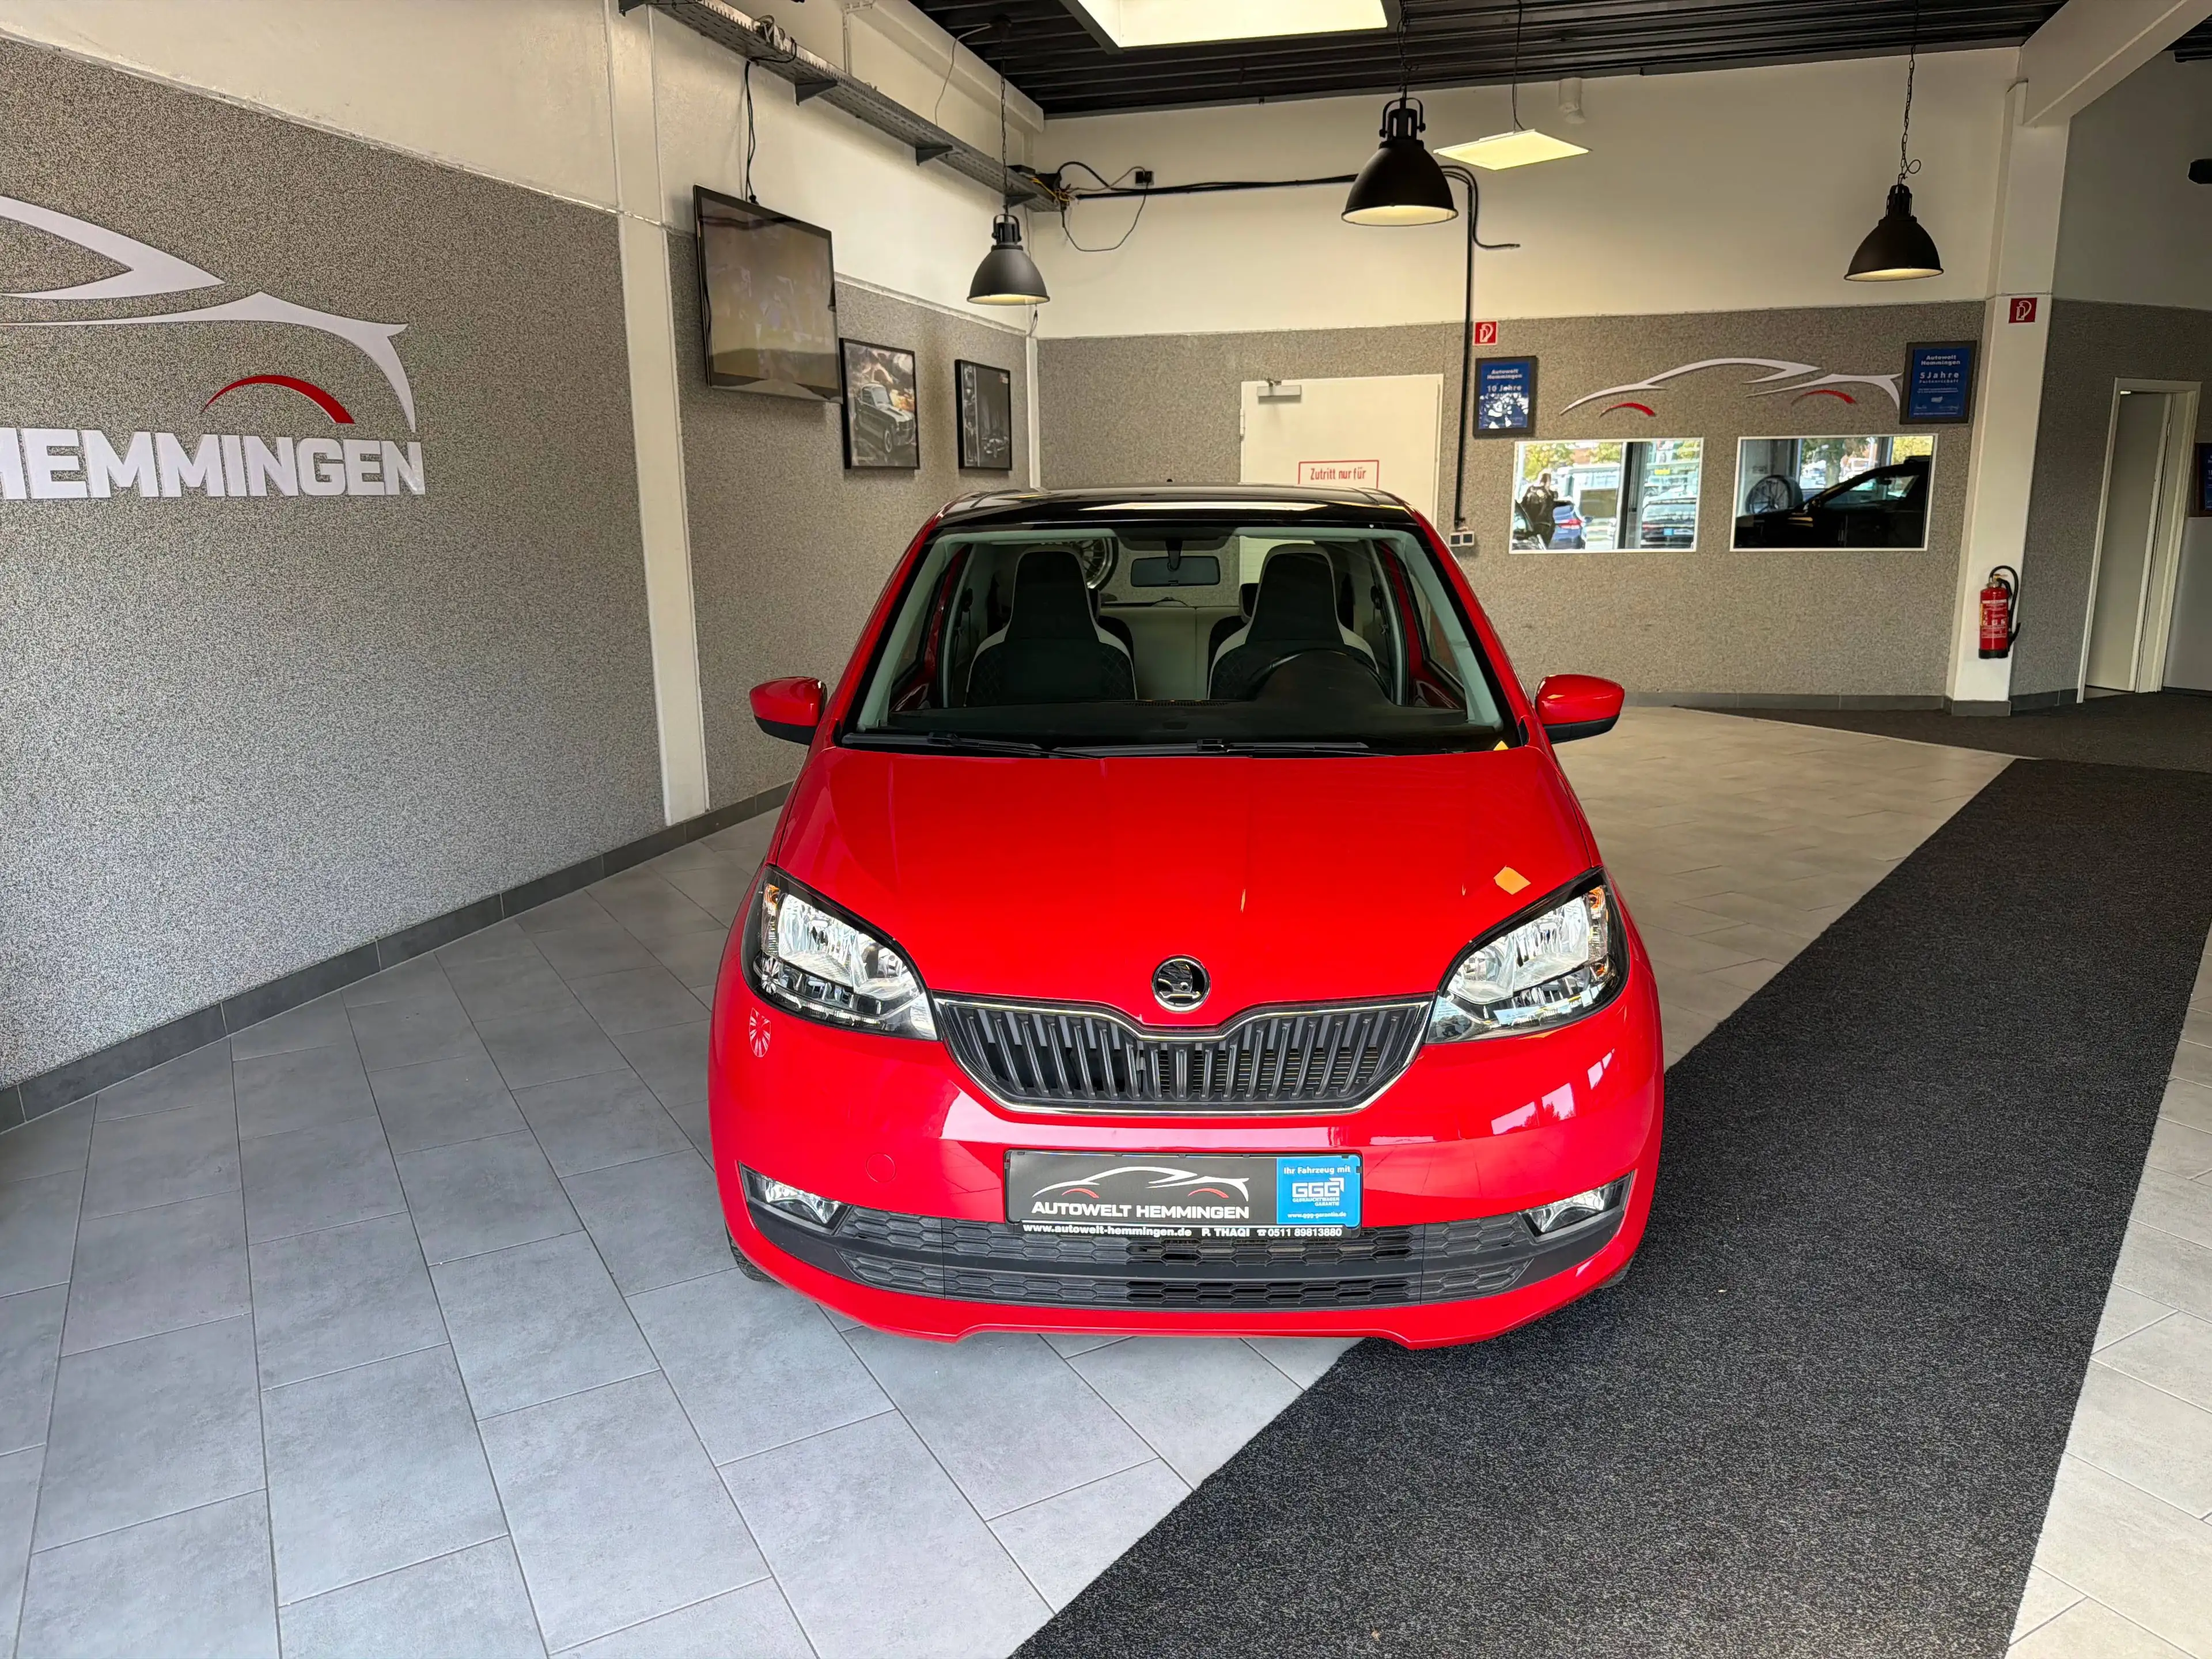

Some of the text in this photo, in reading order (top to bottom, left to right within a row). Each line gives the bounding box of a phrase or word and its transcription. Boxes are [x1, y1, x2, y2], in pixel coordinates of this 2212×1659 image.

[1310, 467, 1366, 480] Zutritt nur für
[1292, 1181, 1340, 1198] GGG
[1031, 1202, 1249, 1218] AUTOWELT HEMMINGEN
[1287, 1211, 1347, 1219] www.ggg-garantie.de
[1022, 1225, 1342, 1237] www.autowelt-hemmingen.de P. THAQI 0511 89813880
